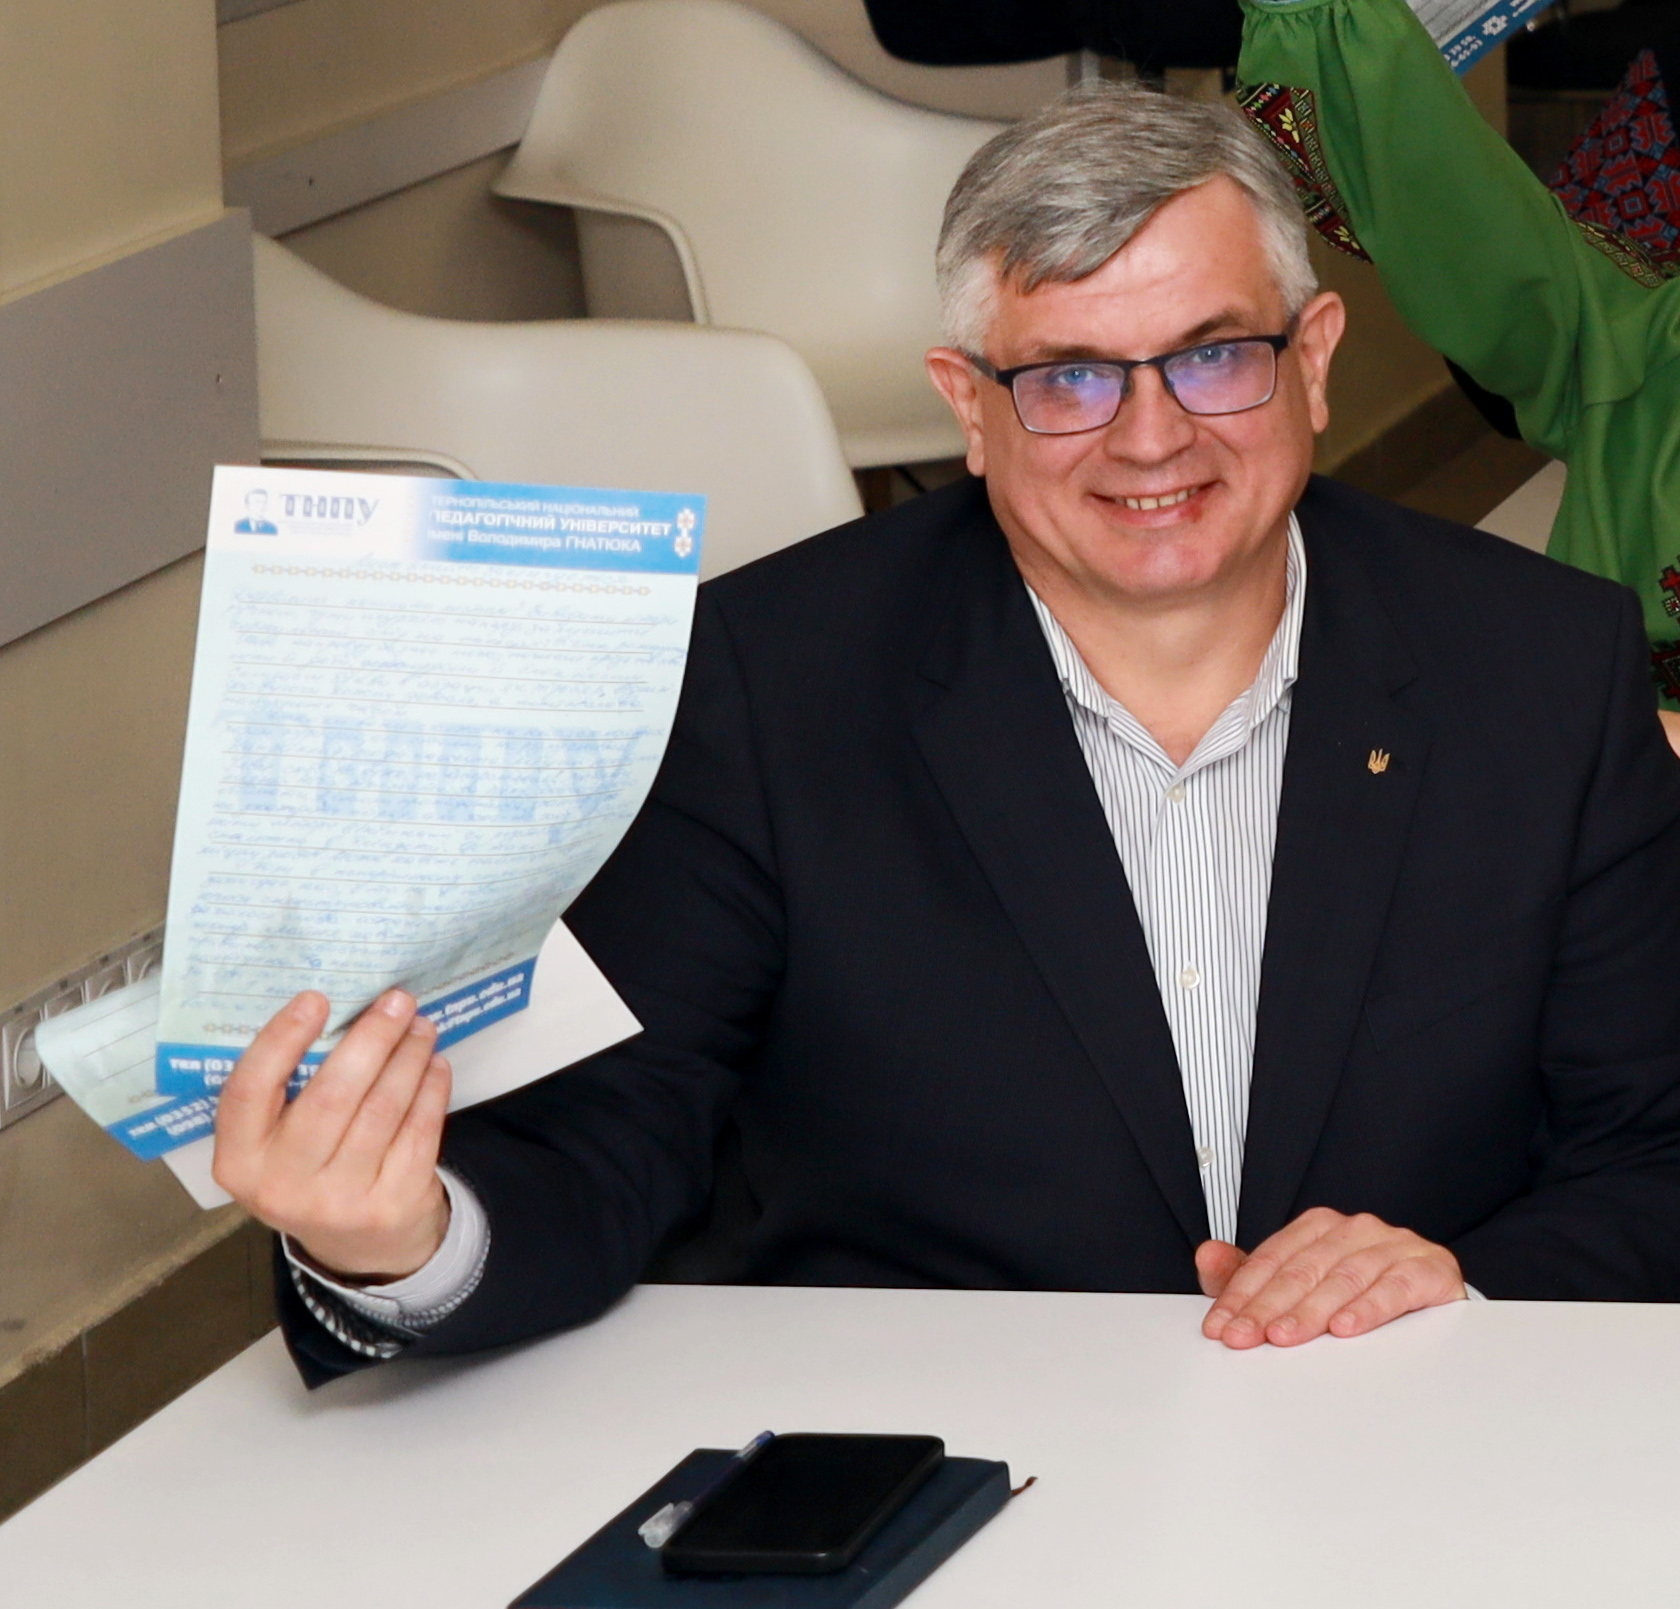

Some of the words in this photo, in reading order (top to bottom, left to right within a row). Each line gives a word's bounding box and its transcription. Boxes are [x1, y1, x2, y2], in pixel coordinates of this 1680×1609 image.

[278, 493, 380, 526] ТНПУ
[541, 503, 640, 519] НАЦІОНАЛЬНИЙ
[558, 517, 671, 538] УНІВЕРСИТЕТ
[467, 529, 561, 550] Володимира
[565, 535, 641, 553] ГНАТЮКА
[215, 714, 648, 842] ТНПУ
[169, 1058, 203, 1072] тел
